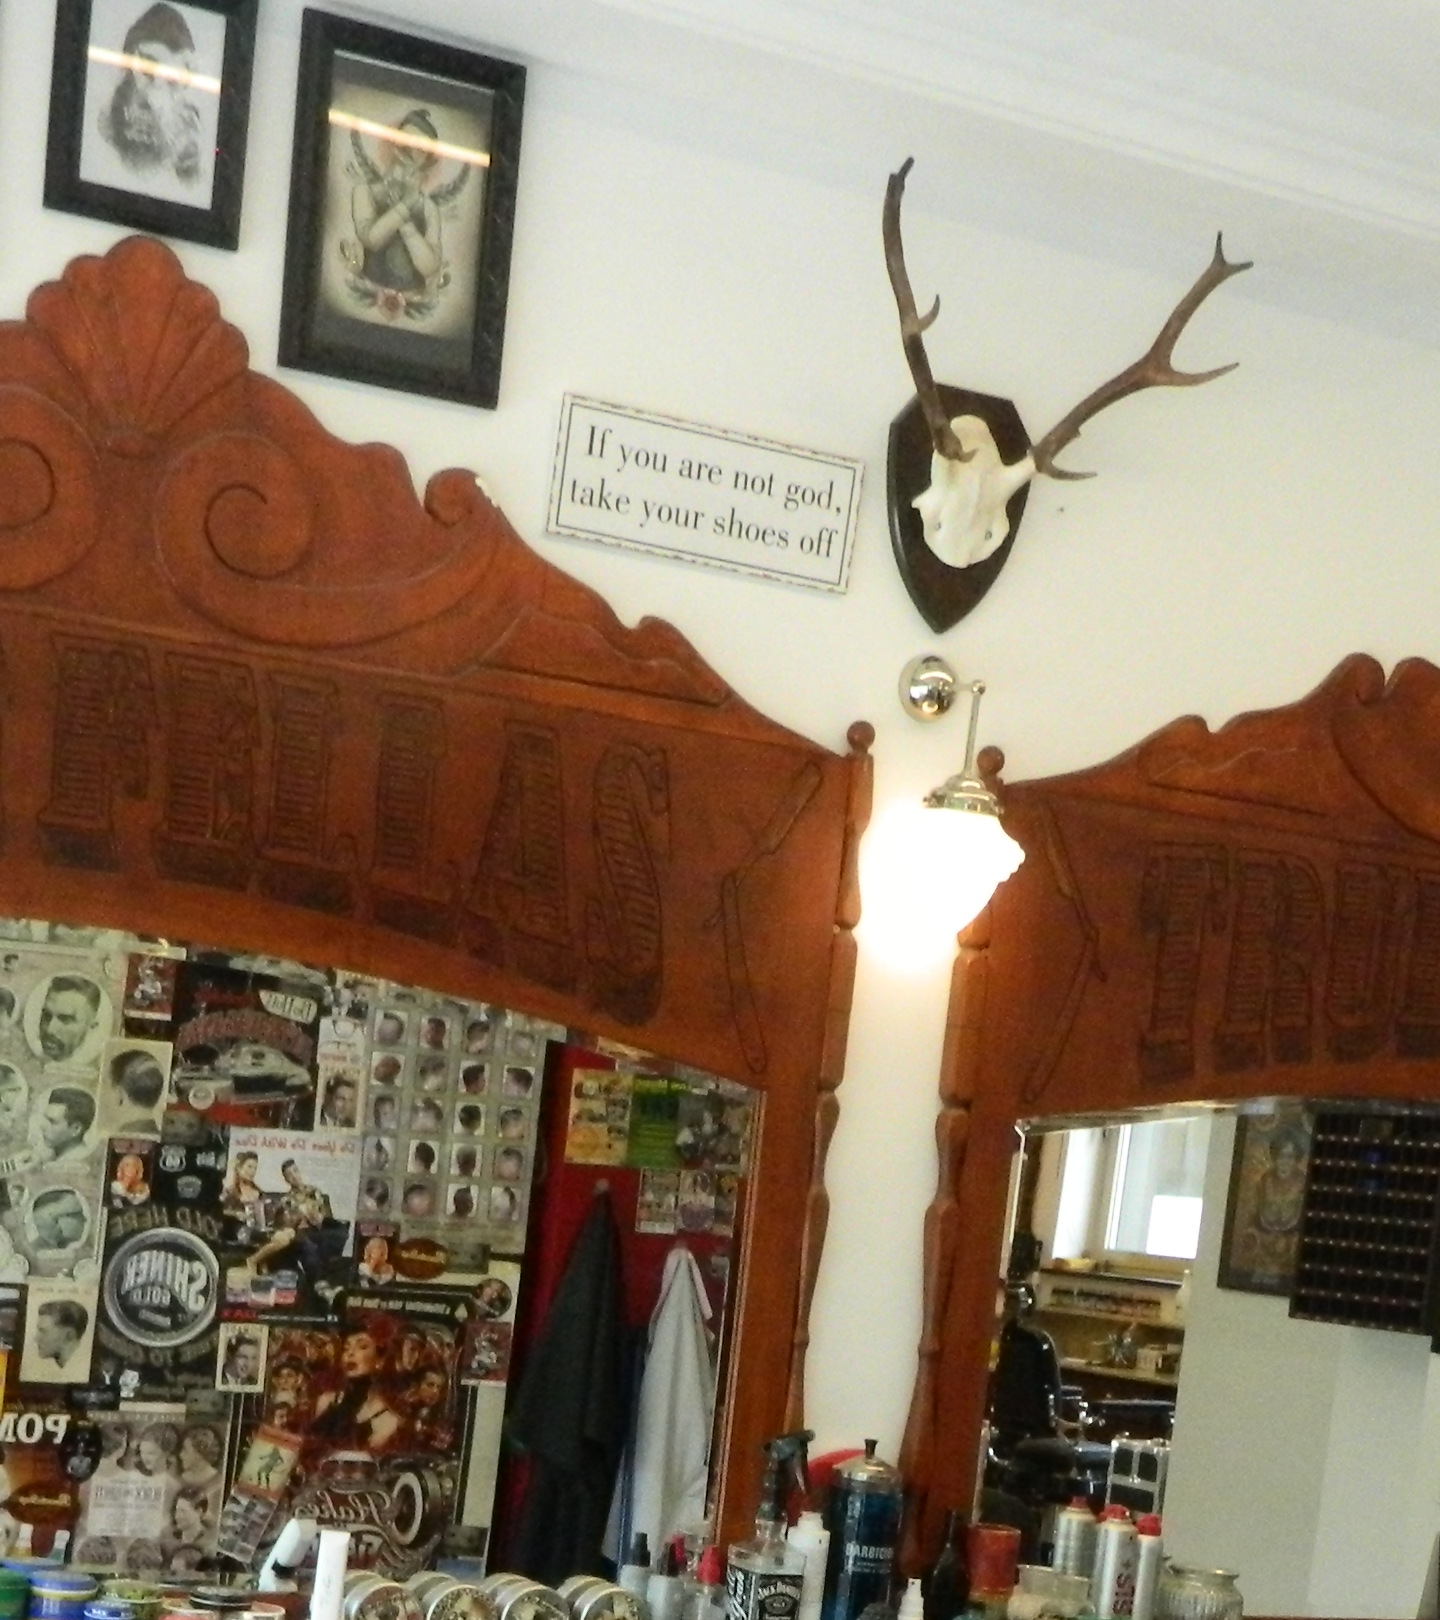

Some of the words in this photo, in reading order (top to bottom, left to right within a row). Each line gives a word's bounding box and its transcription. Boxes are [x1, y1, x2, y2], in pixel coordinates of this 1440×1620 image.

[586, 425, 612, 459] If
[617, 445, 668, 476] you
[678, 457, 722, 485] are
[733, 467, 775, 498] not
[784, 481, 842, 516] god,
[570, 479, 630, 514] take
[643, 499, 705, 531] your
[713, 507, 790, 549] shoes
[799, 527, 839, 559] off
